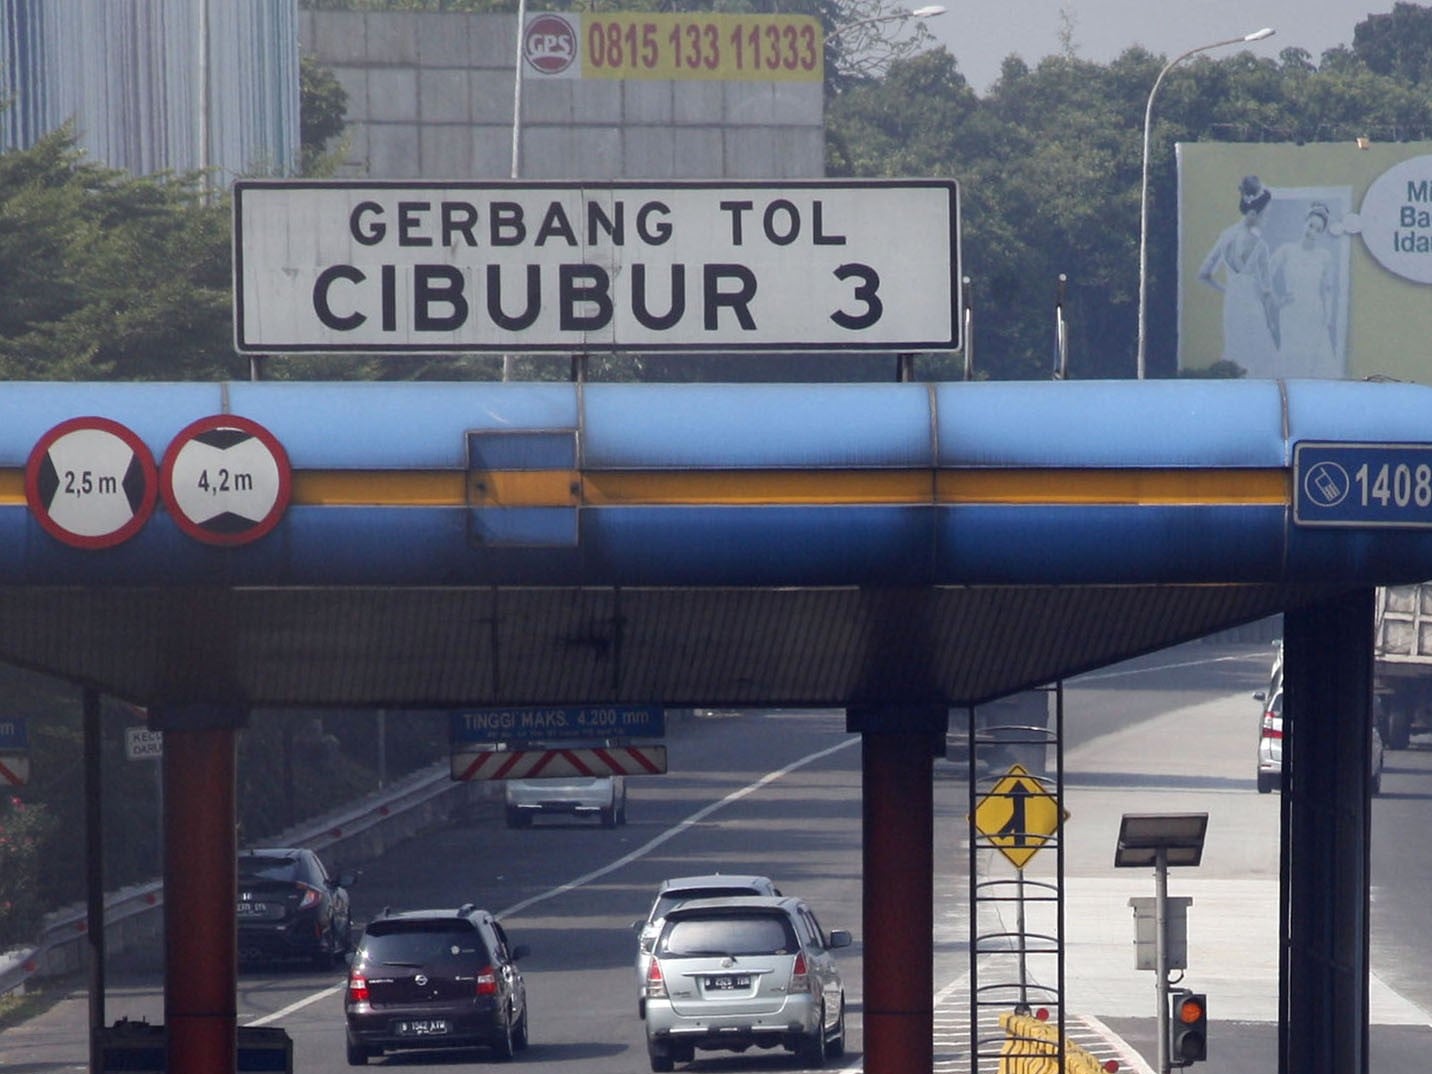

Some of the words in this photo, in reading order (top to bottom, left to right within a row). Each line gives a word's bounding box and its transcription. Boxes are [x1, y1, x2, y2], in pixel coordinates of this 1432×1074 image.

[528, 34, 570, 53] GPS
[588, 22, 659, 69] 0815
[668, 23, 720, 70] 133
[730, 24, 818, 71] 11333
[349, 200, 674, 247] GERBANG
[720, 199, 847, 247] TOL
[312, 263, 758, 332] CIBUBUR
[829, 262, 884, 331] 3
[65, 471, 93, 498] 2,5
[99, 475, 117, 493] m
[198, 468, 230, 496] 4,2
[235, 472, 253, 491] m
[463, 712, 516, 729] TINGGI
[521, 710, 570, 728] MAKS.
[577, 708, 617, 726] 4.200
[622, 709, 649, 723] mm
